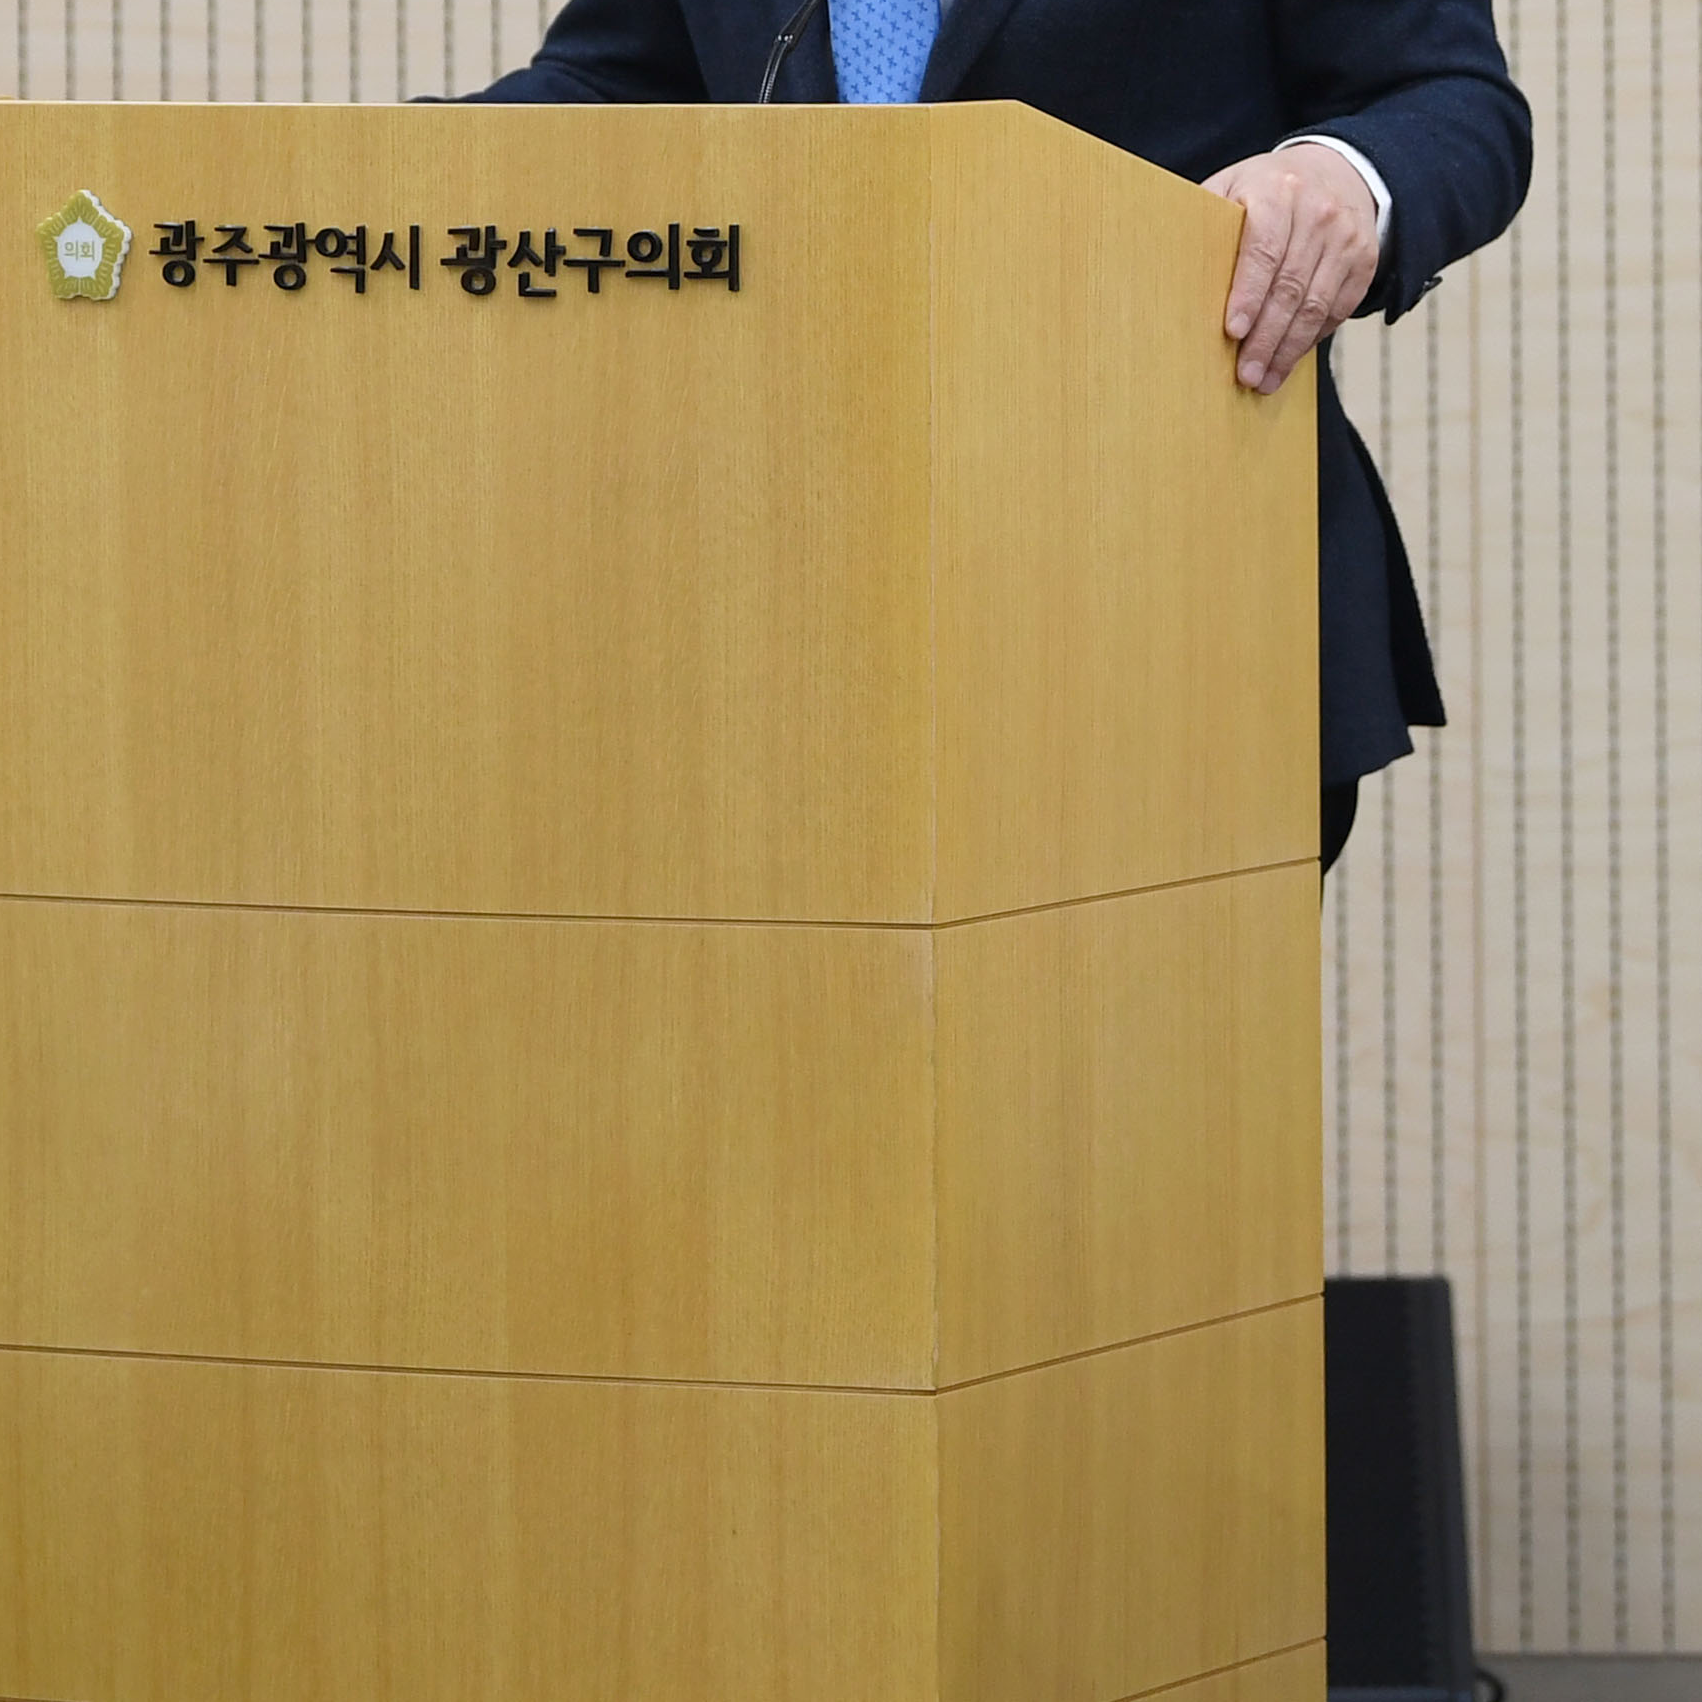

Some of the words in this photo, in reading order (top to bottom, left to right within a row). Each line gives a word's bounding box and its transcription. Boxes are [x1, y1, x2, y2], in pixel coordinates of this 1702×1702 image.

[63, 240, 95, 262] 의회
[149, 220, 420, 294] 광주광역시
[440, 222, 740, 298] 광산구의회
